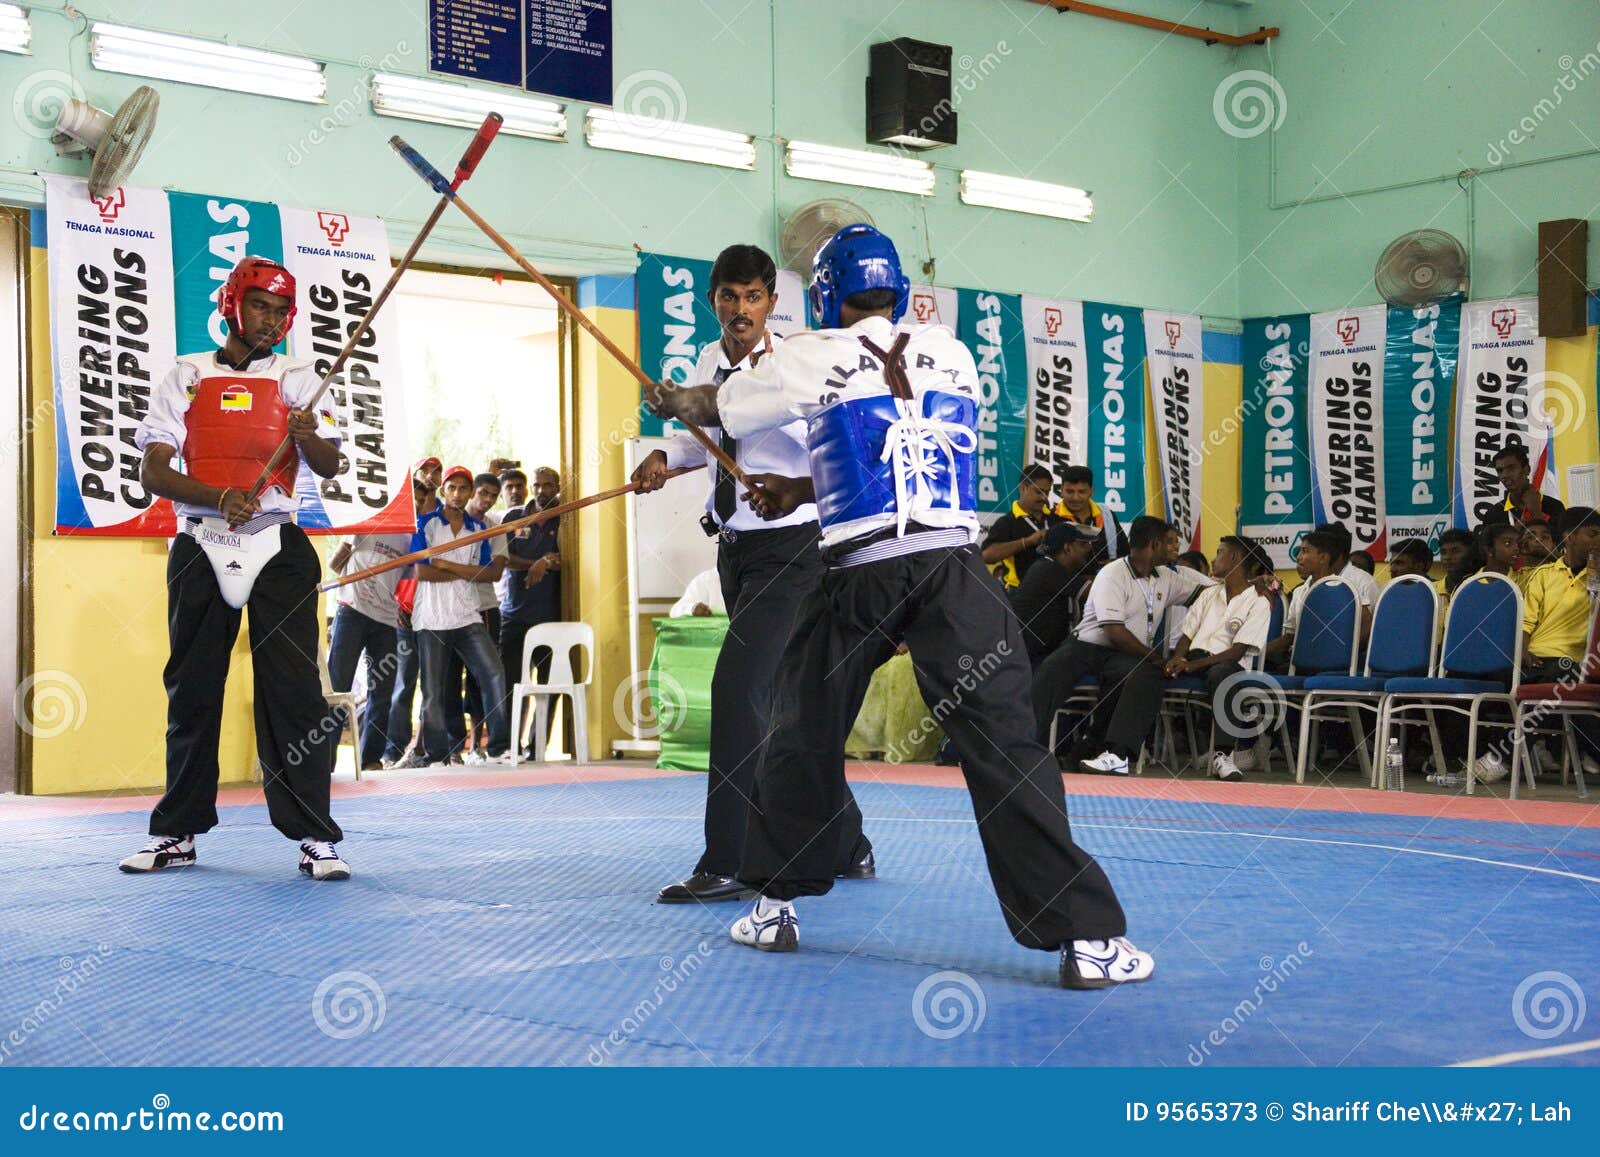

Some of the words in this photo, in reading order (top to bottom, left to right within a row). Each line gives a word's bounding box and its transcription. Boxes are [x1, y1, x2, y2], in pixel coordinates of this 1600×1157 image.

[66, 220, 102, 234] TENAGA
[104, 226, 155, 240] NASIONAL
[297, 245, 331, 257] TENAGA
[333, 250, 377, 262] NASIONAL
[77, 263, 115, 503] POWERING
[113, 247, 153, 510] CHAMPIONS
[309, 284, 353, 504] PERING
[342, 269, 389, 509] CHAMPIONS
[975, 291, 1002, 502] PETRONAS
[1034, 367, 1051, 464] ERING
[1101, 312, 1127, 513] PETRONAS
[1264, 322, 1294, 516] PETRONAS
[1319, 349, 1346, 358] TENAGA
[1347, 344, 1377, 354] NASIONAL
[1411, 303, 1441, 505] PETRONAS
[1472, 341, 1500, 350] TENAGA
[1502, 339, 1535, 348] NASIONAL
[1505, 356, 1529, 456] PIONS
[1326, 377, 1353, 520] OWERING
[1352, 361, 1378, 544] CHAMPIONS
[1474, 371, 1502, 525] OWERING
[1250, 536, 1290, 546] TRONAS
[1390, 527, 1430, 538] PETRONAS
